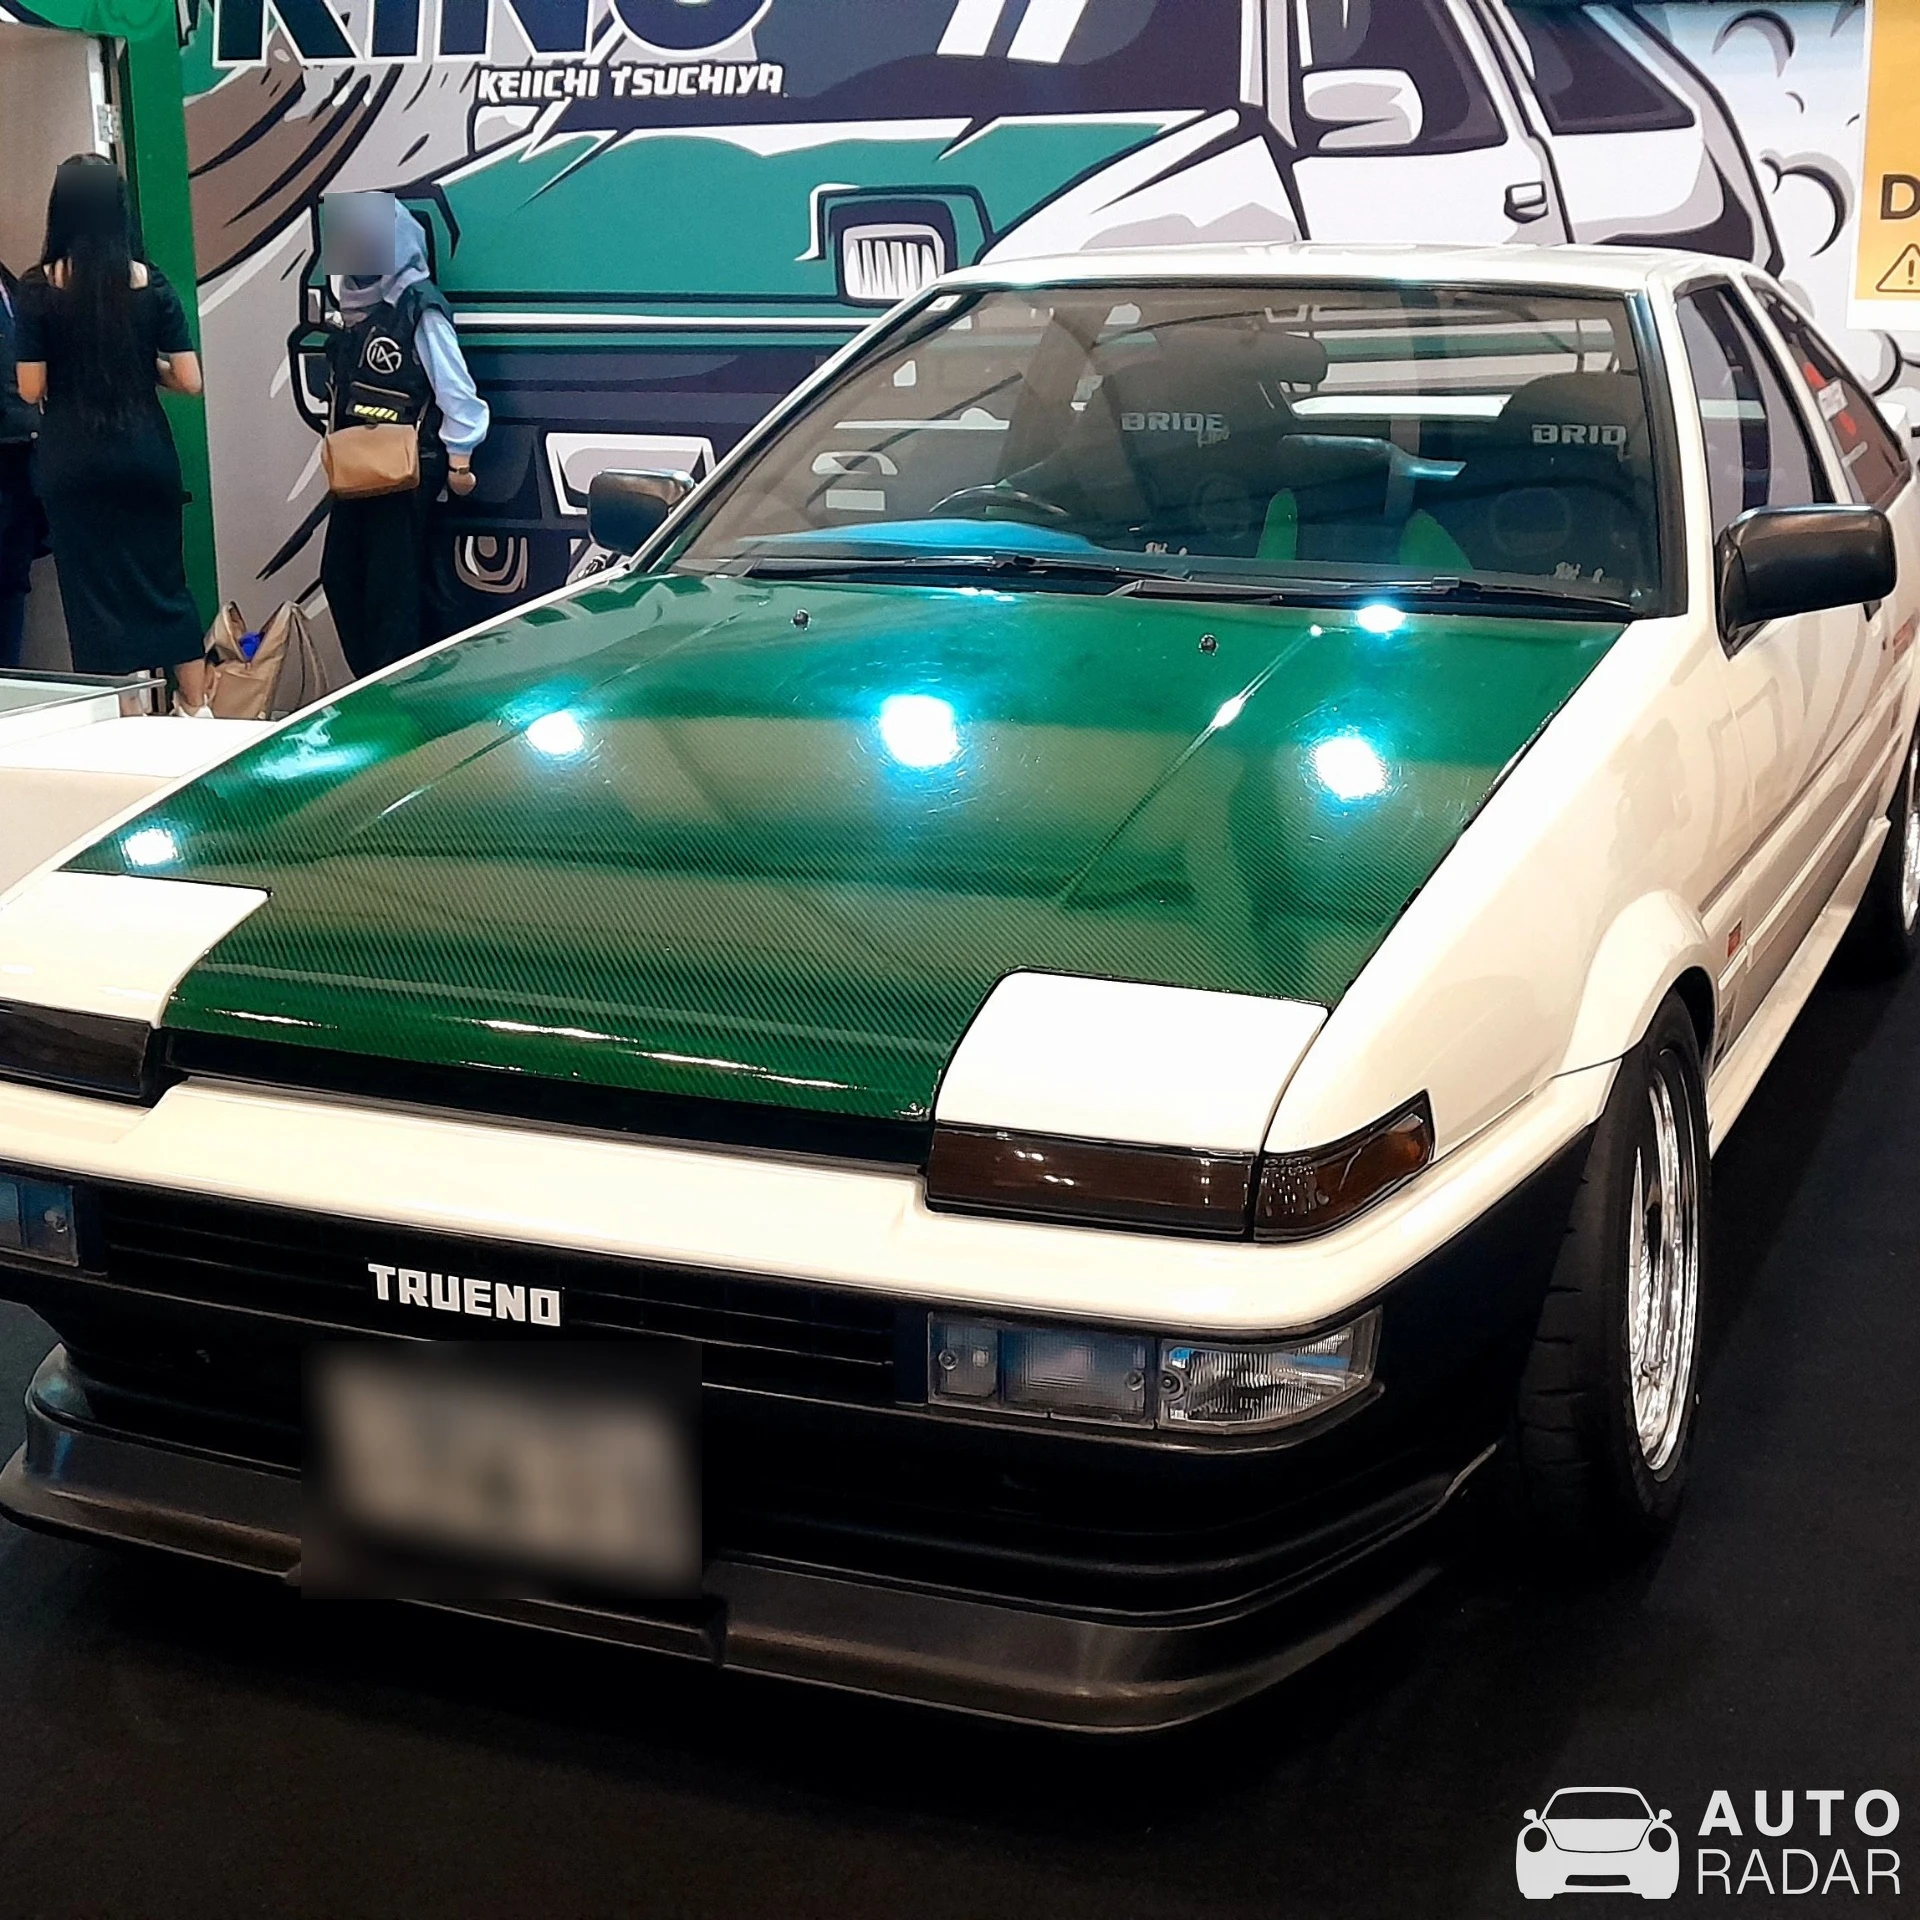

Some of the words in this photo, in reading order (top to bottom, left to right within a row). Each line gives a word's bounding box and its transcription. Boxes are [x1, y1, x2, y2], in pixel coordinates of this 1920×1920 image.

[478, 67, 600, 102] KEIICHI
[611, 62, 784, 97] TSUCHIYA
[1120, 412, 1223, 432] BRIDE
[367, 1262, 562, 1328] TRUENO
